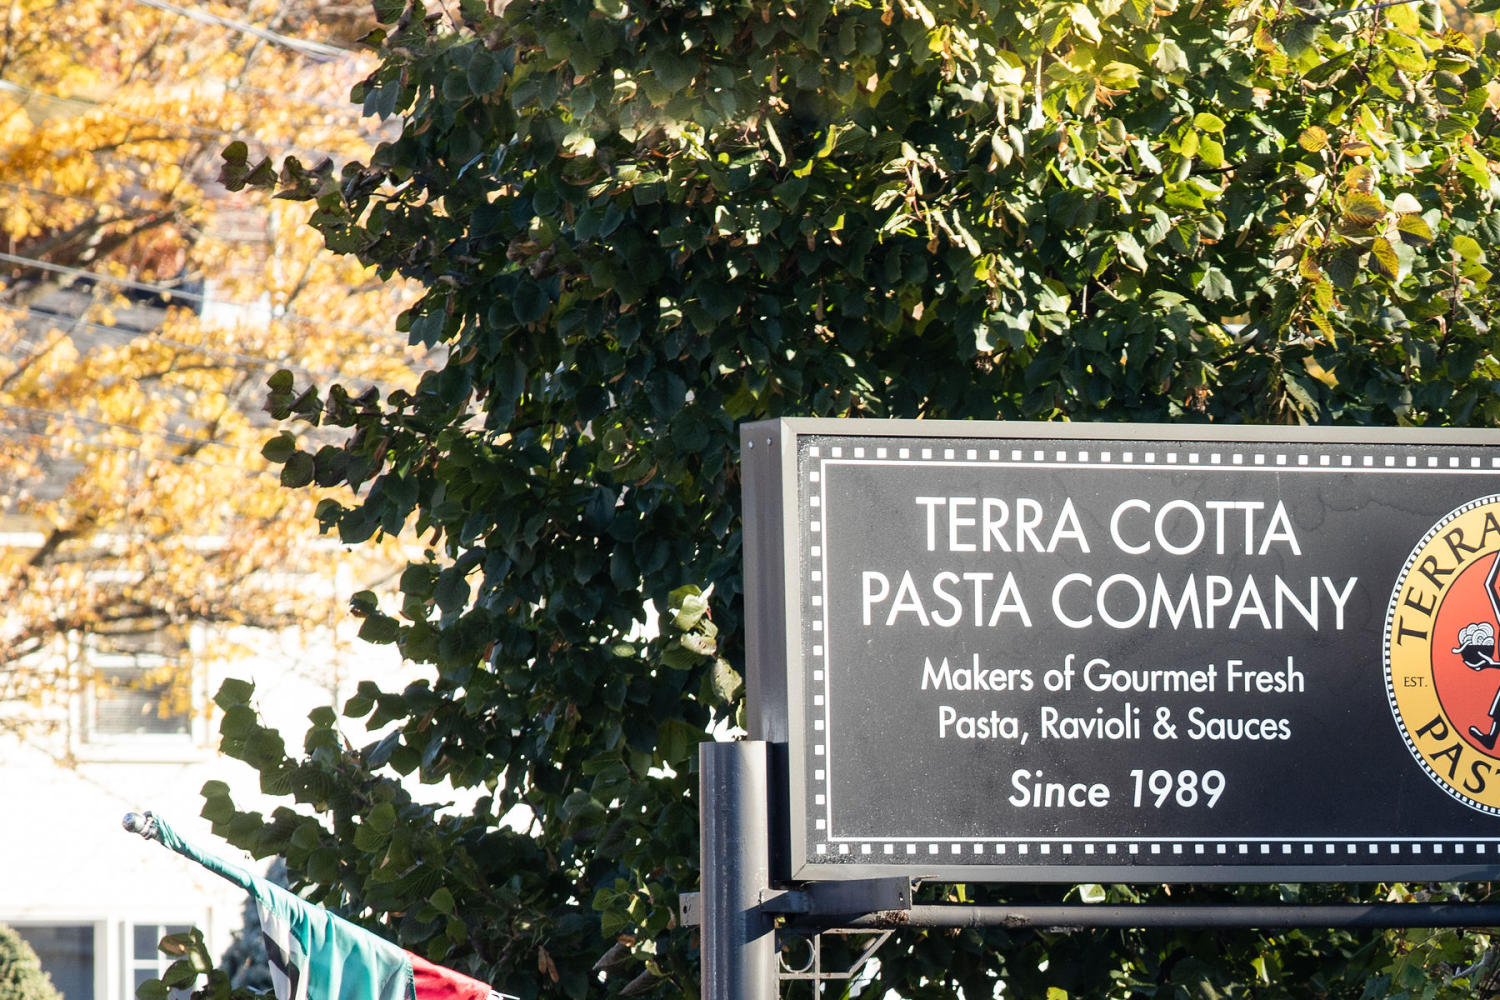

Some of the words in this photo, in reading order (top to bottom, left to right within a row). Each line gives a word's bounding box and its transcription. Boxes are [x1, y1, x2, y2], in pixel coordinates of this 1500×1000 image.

[915, 496, 1091, 554] TERRA
[1109, 498, 1302, 556] COTTA
[862, 569, 1033, 628] PASTA
[1051, 572, 1358, 632] COMPANY
[920, 652, 1034, 692] Makers
[1043, 653, 1076, 692] of
[1083, 658, 1218, 693] Gourmet
[1227, 655, 1305, 693] Fresh
[1403, 676, 1429, 689] EST.
[938, 705, 1029, 746] Pasta,
[1040, 703, 1140, 740] Ravioli
[1152, 706, 1178, 740] &
[1187, 706, 1292, 740] Sauces
[1008, 768, 1111, 808] Since
[1129, 769, 1226, 809] 1989
